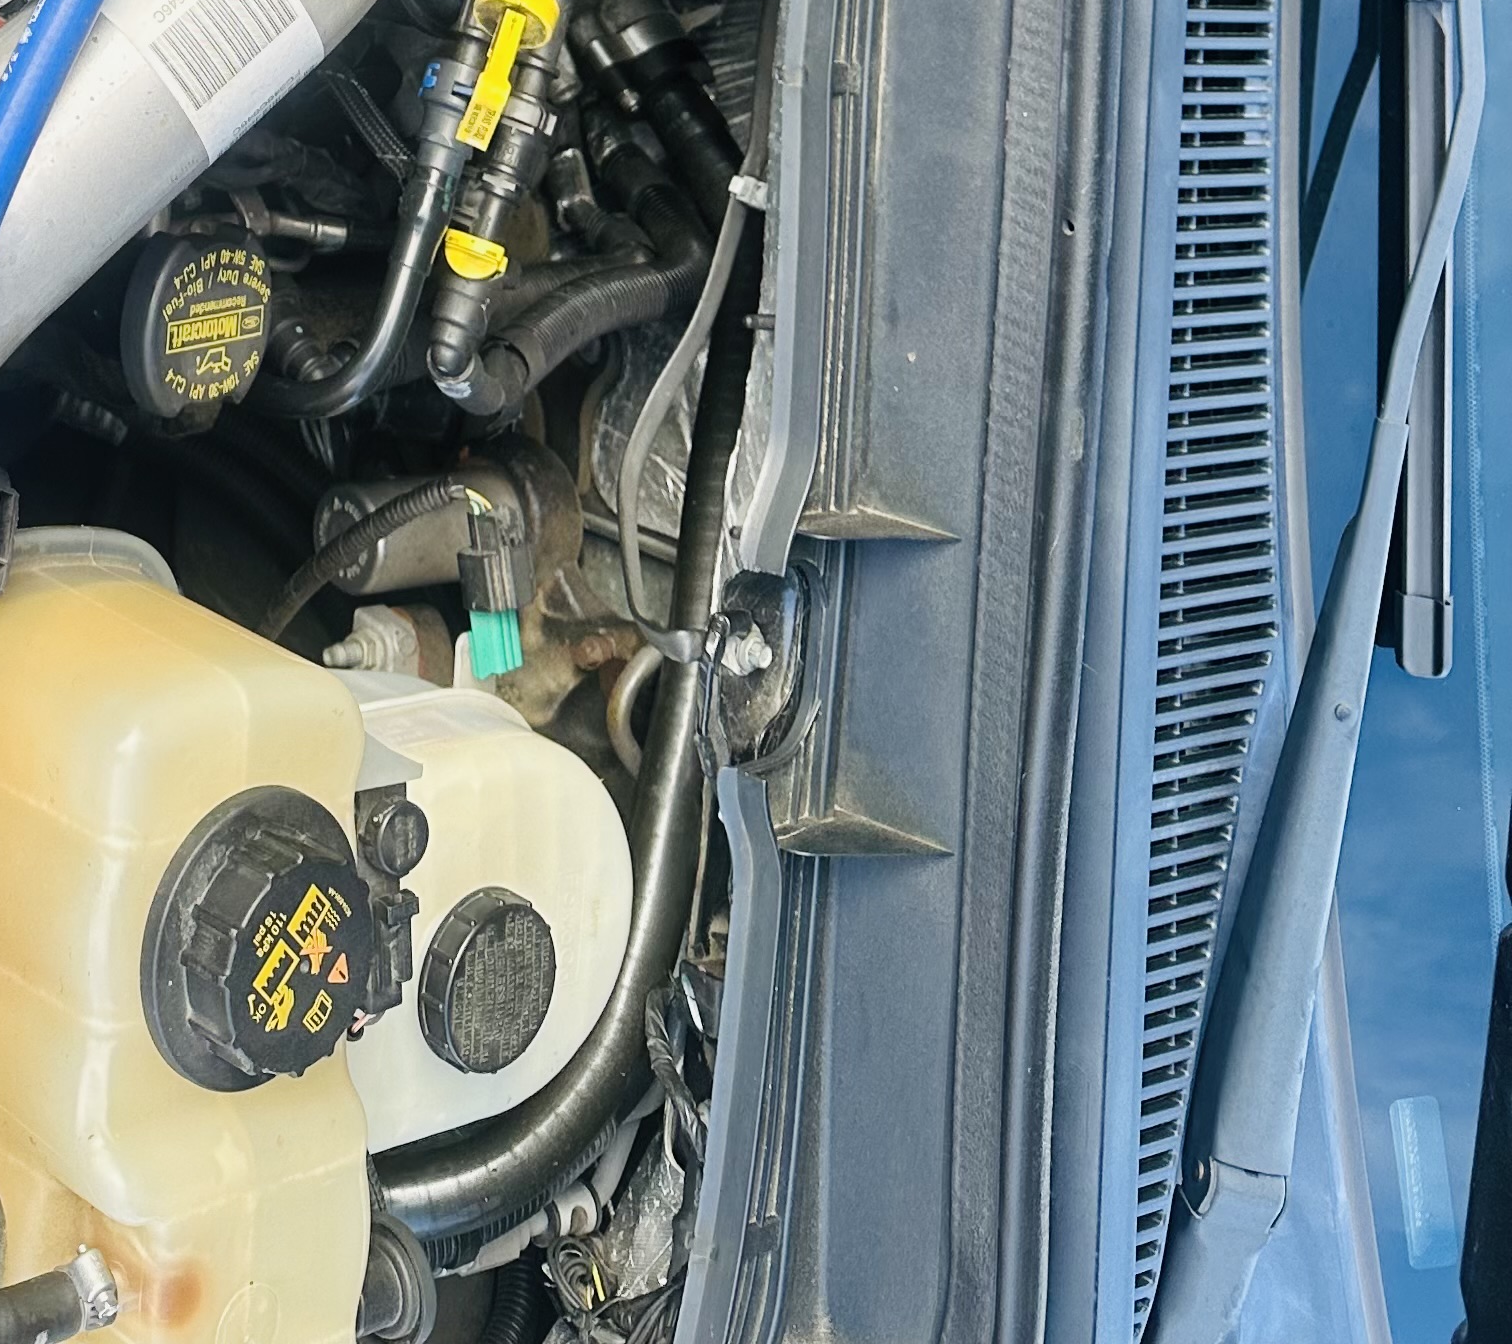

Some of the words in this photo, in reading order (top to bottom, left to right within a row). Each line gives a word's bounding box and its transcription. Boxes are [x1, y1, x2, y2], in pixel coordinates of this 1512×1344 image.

[200, 251, 216, 272] API
[220, 248, 246, 265] 5W-40
[249, 253, 265, 275] SAE
[173, 262, 196, 289] CJ-4
[217, 267, 239, 286] Duty
[243, 271, 271, 303] Severe
[162, 278, 203, 322] Bio-Fuel
[189, 295, 247, 317] Recommended
[170, 314, 237, 349] Motorcraft
[243, 350, 259, 377] SAE
[164, 368, 186, 393] CJ-4
[189, 382, 206, 401] API
[208, 371, 240, 399] 10W-30
[264, 910, 276, 927] 16
[270, 911, 287, 935] 110
[253, 925, 267, 948] psi
[252, 1003, 266, 1023] OK
